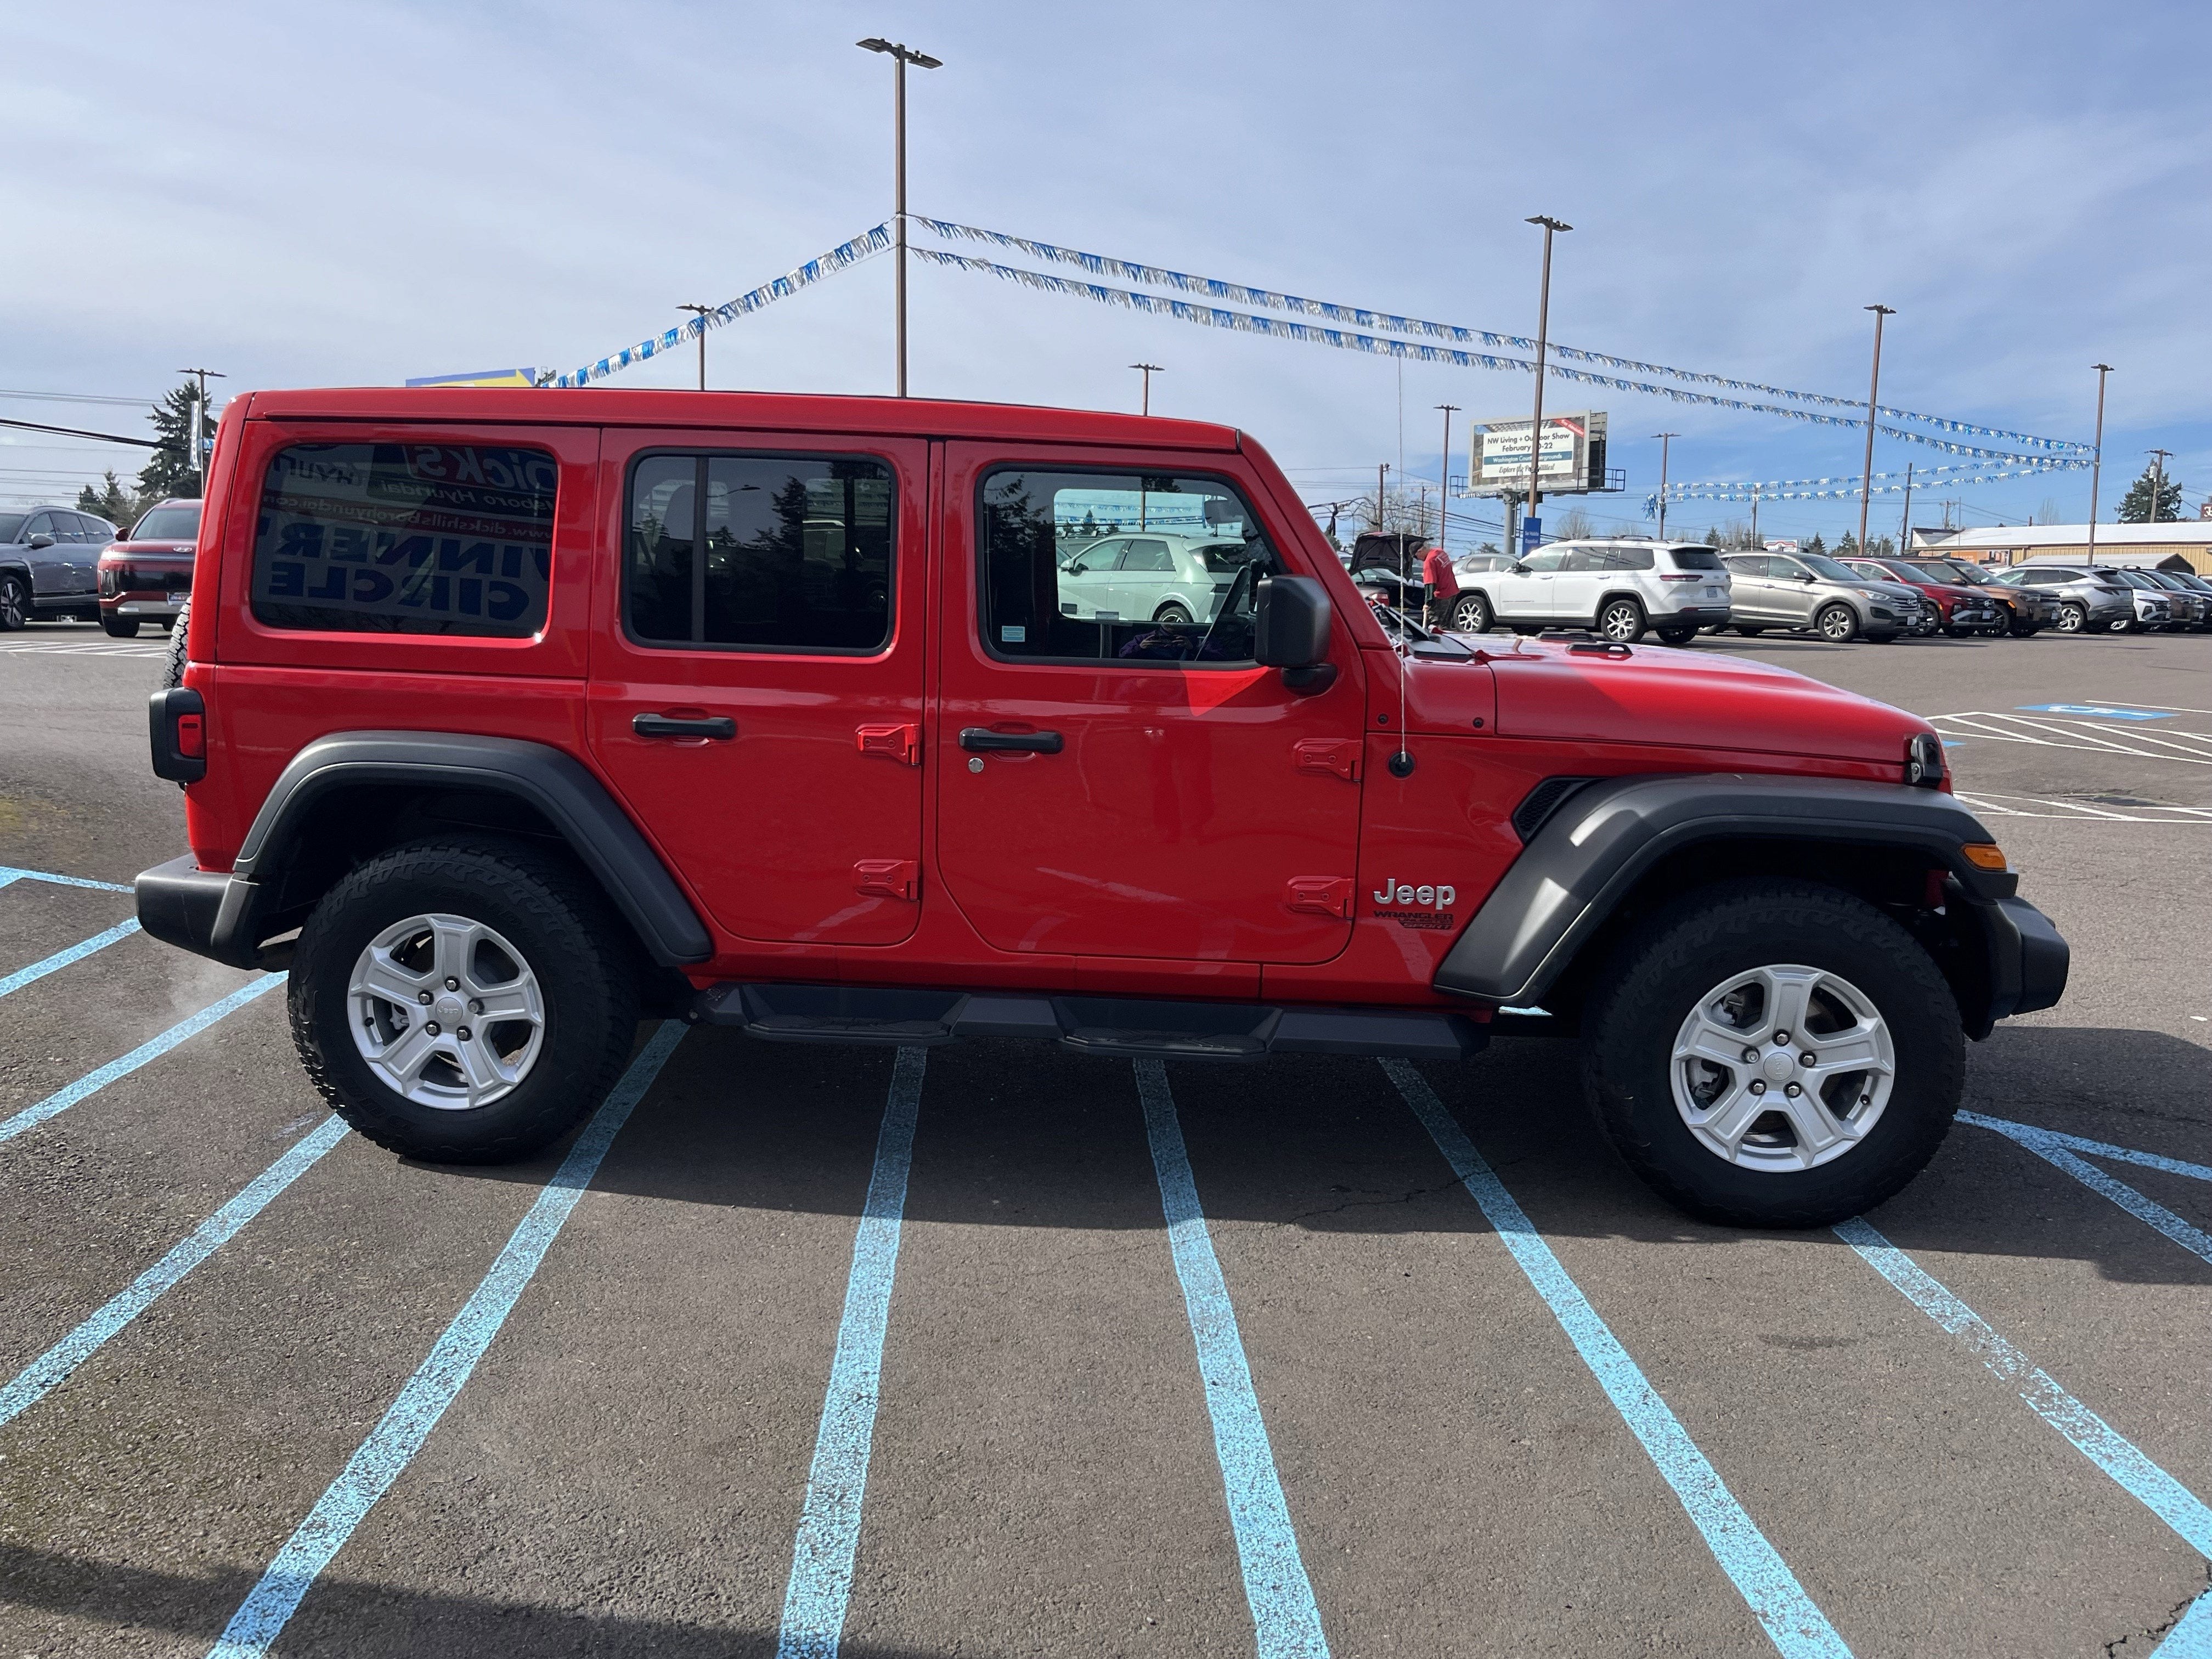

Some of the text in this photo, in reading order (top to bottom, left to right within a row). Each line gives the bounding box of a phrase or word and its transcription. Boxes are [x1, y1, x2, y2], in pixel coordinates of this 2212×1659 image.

[1500, 436, 1517, 444] Living
[1538, 453, 1562, 461] airgrounds
[1373, 878, 1455, 910] Jeep
[1373, 911, 1454, 920] WRANGLER
